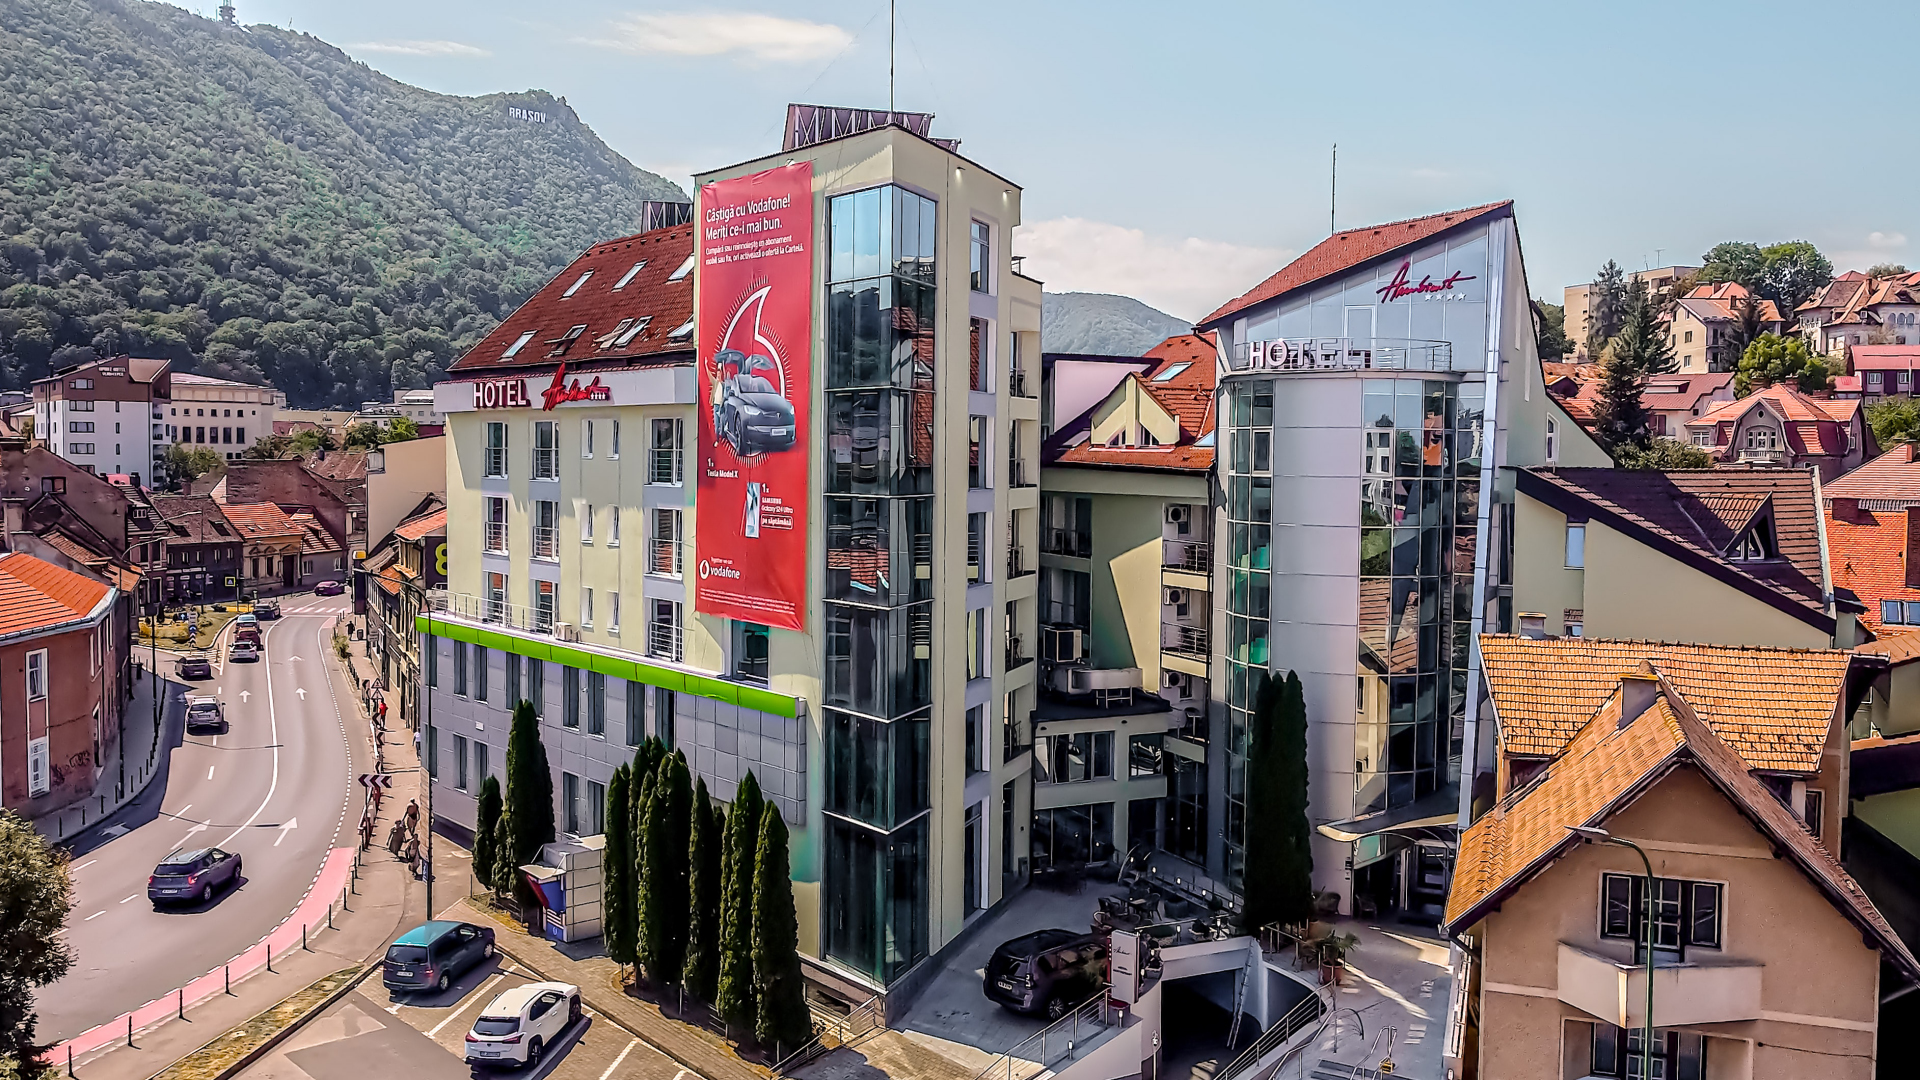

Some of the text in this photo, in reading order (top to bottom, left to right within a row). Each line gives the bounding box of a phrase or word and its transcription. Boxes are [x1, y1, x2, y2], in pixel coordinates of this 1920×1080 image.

[706, 193, 791, 224] Câștigă cu Vodafone!
[705, 217, 783, 241] Meriți ce-i mai bun.
[759, 239, 765, 247] un
[765, 234, 792, 246] abonament
[706, 257, 717, 265] mobil
[717, 255, 725, 264] sau
[779, 245, 785, 254] la
[1376, 262, 1477, 304] Ambient
[1249, 338, 1363, 369] HOTEL
[473, 380, 527, 407] HOTEL
[706, 469, 739, 478] Tesla Model X
[435, 543, 447, 576] 8
[710, 565, 740, 579] vodafone
